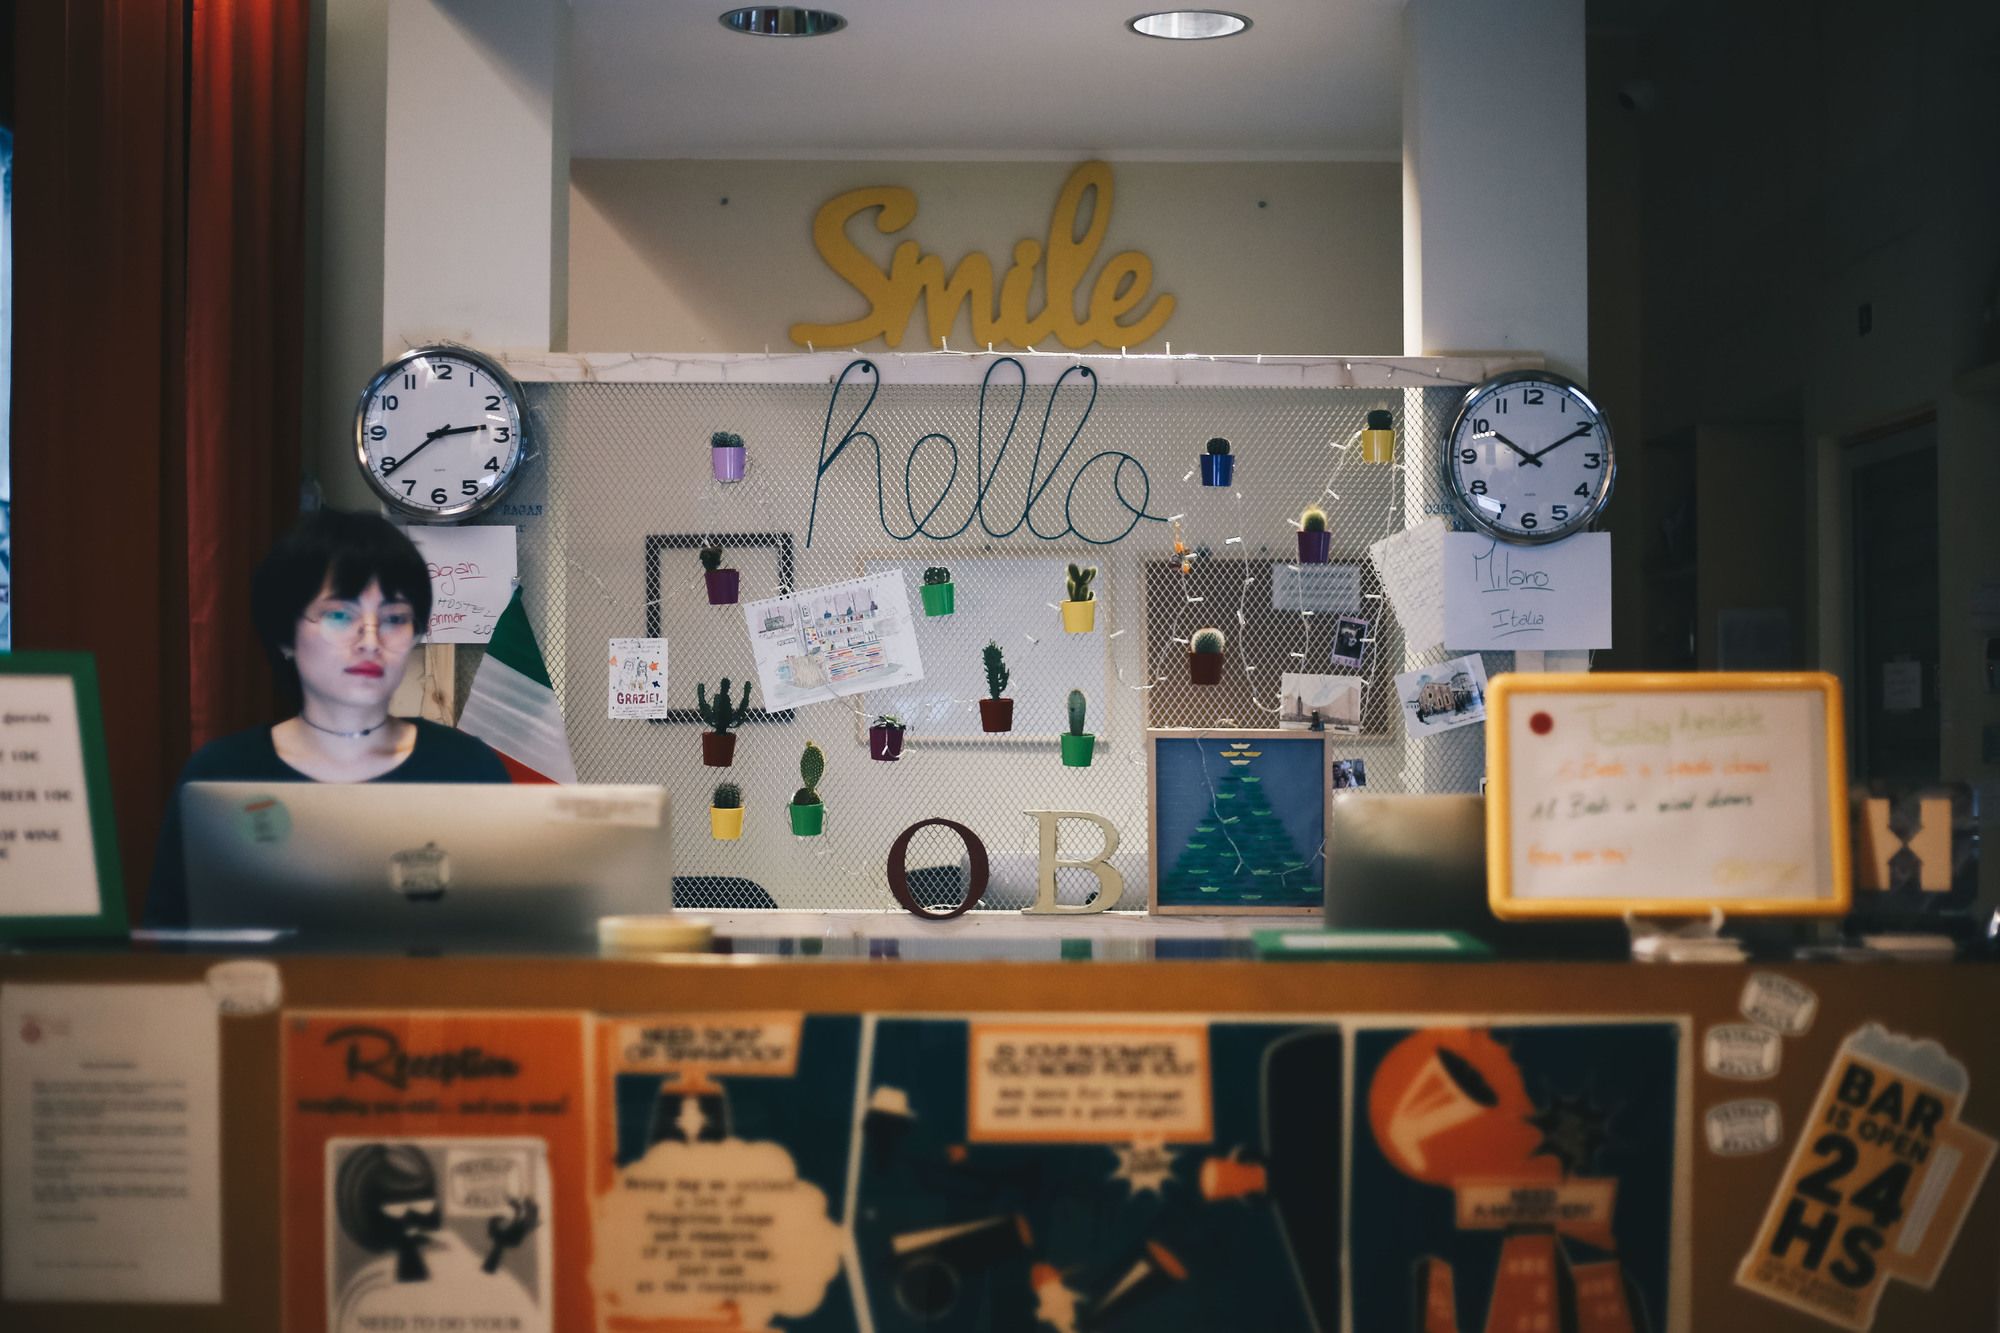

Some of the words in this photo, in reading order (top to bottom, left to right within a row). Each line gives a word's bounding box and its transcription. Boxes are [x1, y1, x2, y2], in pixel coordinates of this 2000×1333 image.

[787, 159, 1179, 349] Smile
[432, 365, 453, 380] 12
[469, 372, 474, 388] 1
[404, 374, 416, 390] 11
[382, 395, 399, 411] 10
[484, 395, 501, 411] 2
[1523, 389, 1544, 405] 12
[1561, 397, 1566, 413] 1
[1495, 398, 1508, 414] 11
[370, 425, 387, 441] 9
[1472, 418, 1490, 434] 10
[1575, 421, 1593, 437] 2
[493, 427, 510, 443] 3
[806, 357, 1169, 549] hello
[1460, 448, 1477, 465] 9
[1583, 453, 1600, 469] 3
[380, 456, 397, 473] 8
[483, 456, 500, 472] 4
[402, 480, 417, 496] 7
[461, 480, 479, 496] 5
[1469, 480, 1488, 496] 8
[1574, 482, 1590, 498] 4
[430, 488, 448, 505] 6
[1493, 503, 1507, 520] 7
[1551, 505, 1569, 521] 5
[1520, 512, 1538, 529] 6
[1472, 540, 1550, 589] Milano
[425, 561, 481, 597] agan
[1490, 608, 1545, 629] Italia
[473, 624, 497, 636] 20
[616, 691, 660, 705] GRAZIE!
[887, 817, 990, 921] O
[1021, 809, 1124, 916] B
[324, 1024, 522, 1092] Reception
[1836, 1062, 1945, 1138] BAR
[1825, 1103, 1853, 1133] IS
[1857, 1120, 1931, 1165] OPEN
[1795, 1132, 1914, 1228] 24
[1770, 1197, 1886, 1290] HS
